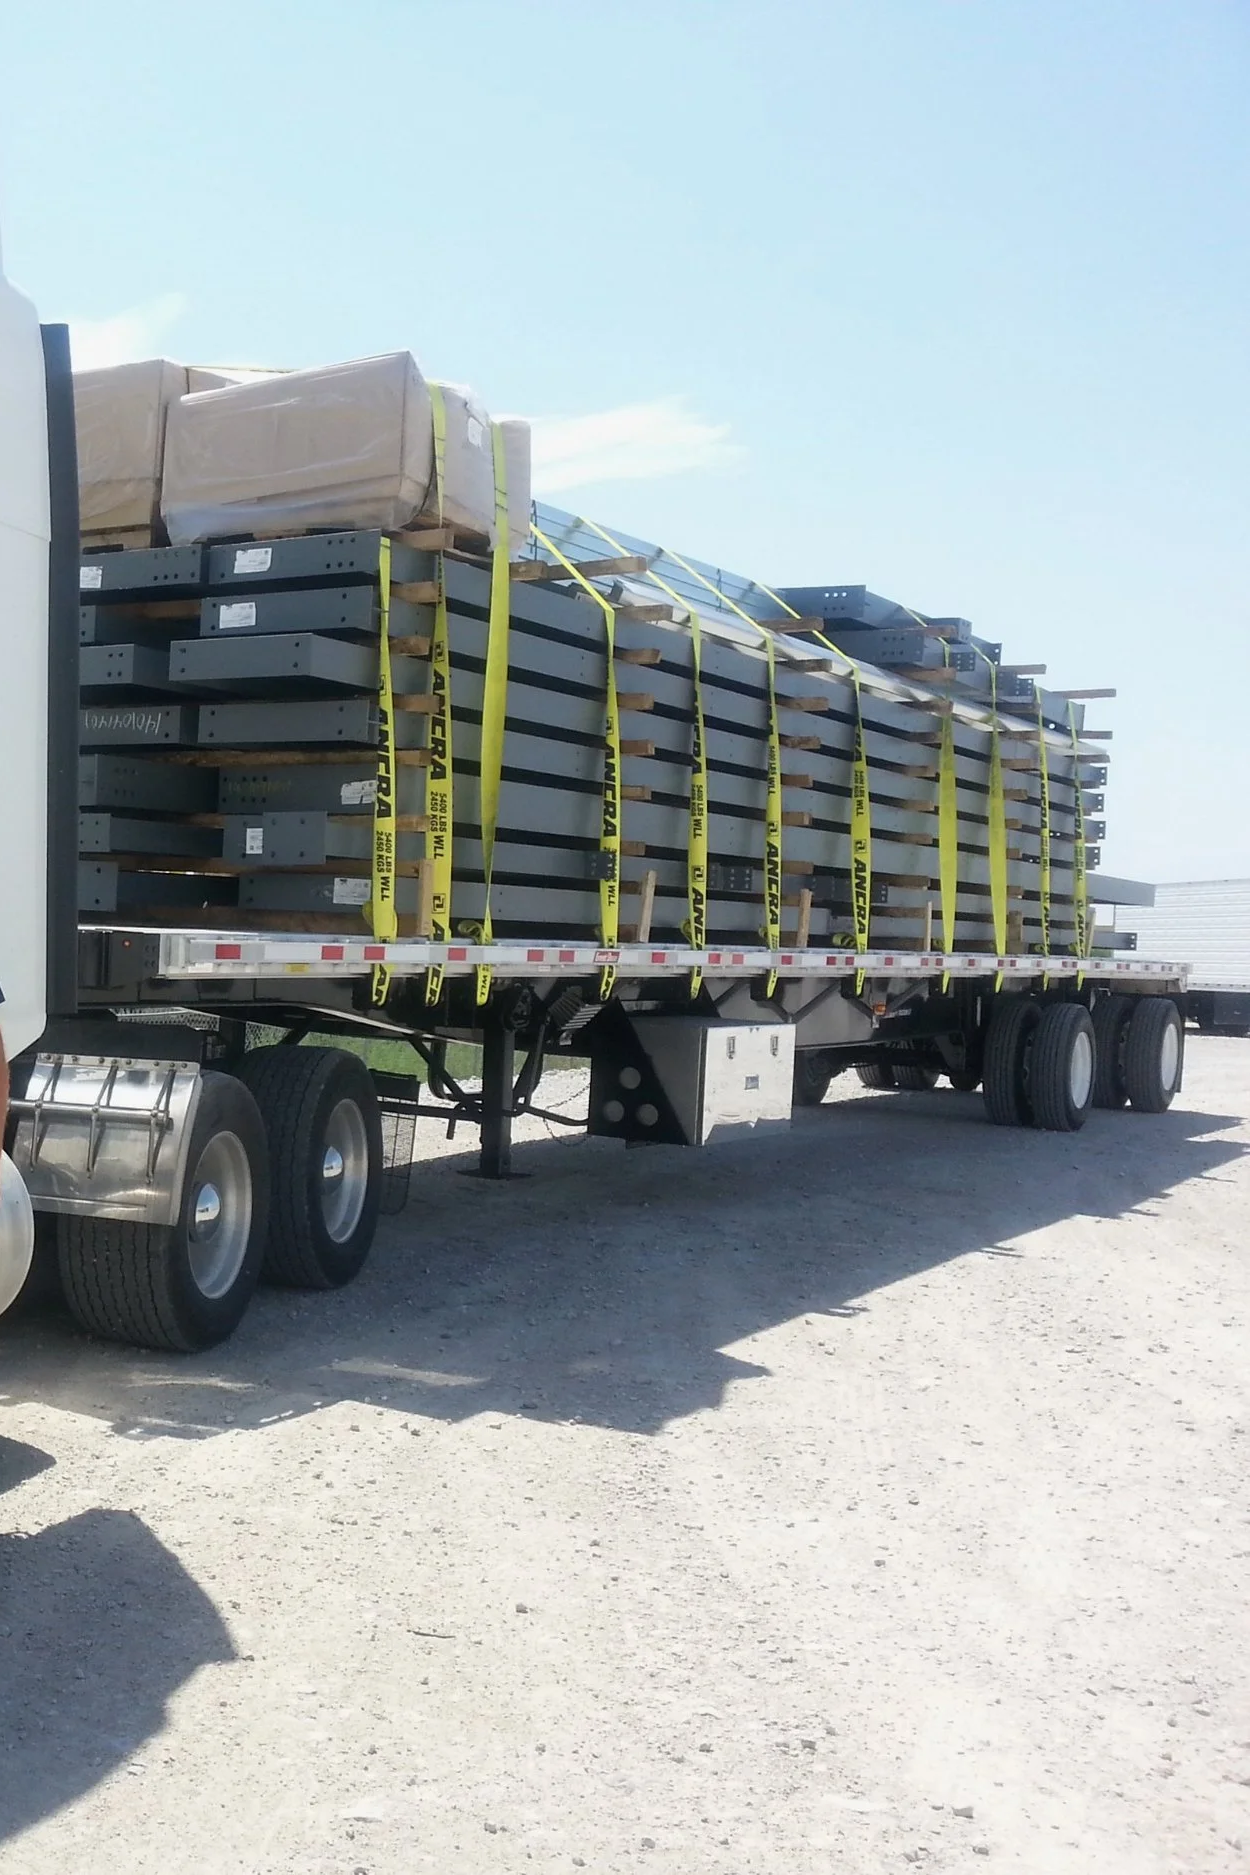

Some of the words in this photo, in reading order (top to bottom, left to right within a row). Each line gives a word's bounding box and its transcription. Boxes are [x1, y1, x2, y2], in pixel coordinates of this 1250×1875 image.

[431, 669, 447, 780] ANCRA
[604, 744, 617, 837] ANCRA
[430, 791, 438, 812] 2450
[439, 793, 447, 813] 5400
[430, 813, 438, 832] KGS
[439, 814, 447, 833] LBS
[693, 818, 702, 839] WLL
[376, 831, 384, 852] 2450
[384, 832, 392, 853] 5400
[434, 834, 445, 859] WLL
[376, 853, 384, 873] KGS
[384, 854, 392, 873] LBS
[381, 876, 391, 902] WLL
[767, 841, 779, 925] ANCRA
[607, 885, 616, 907] WLL
[854, 858, 867, 934] ANCRA
